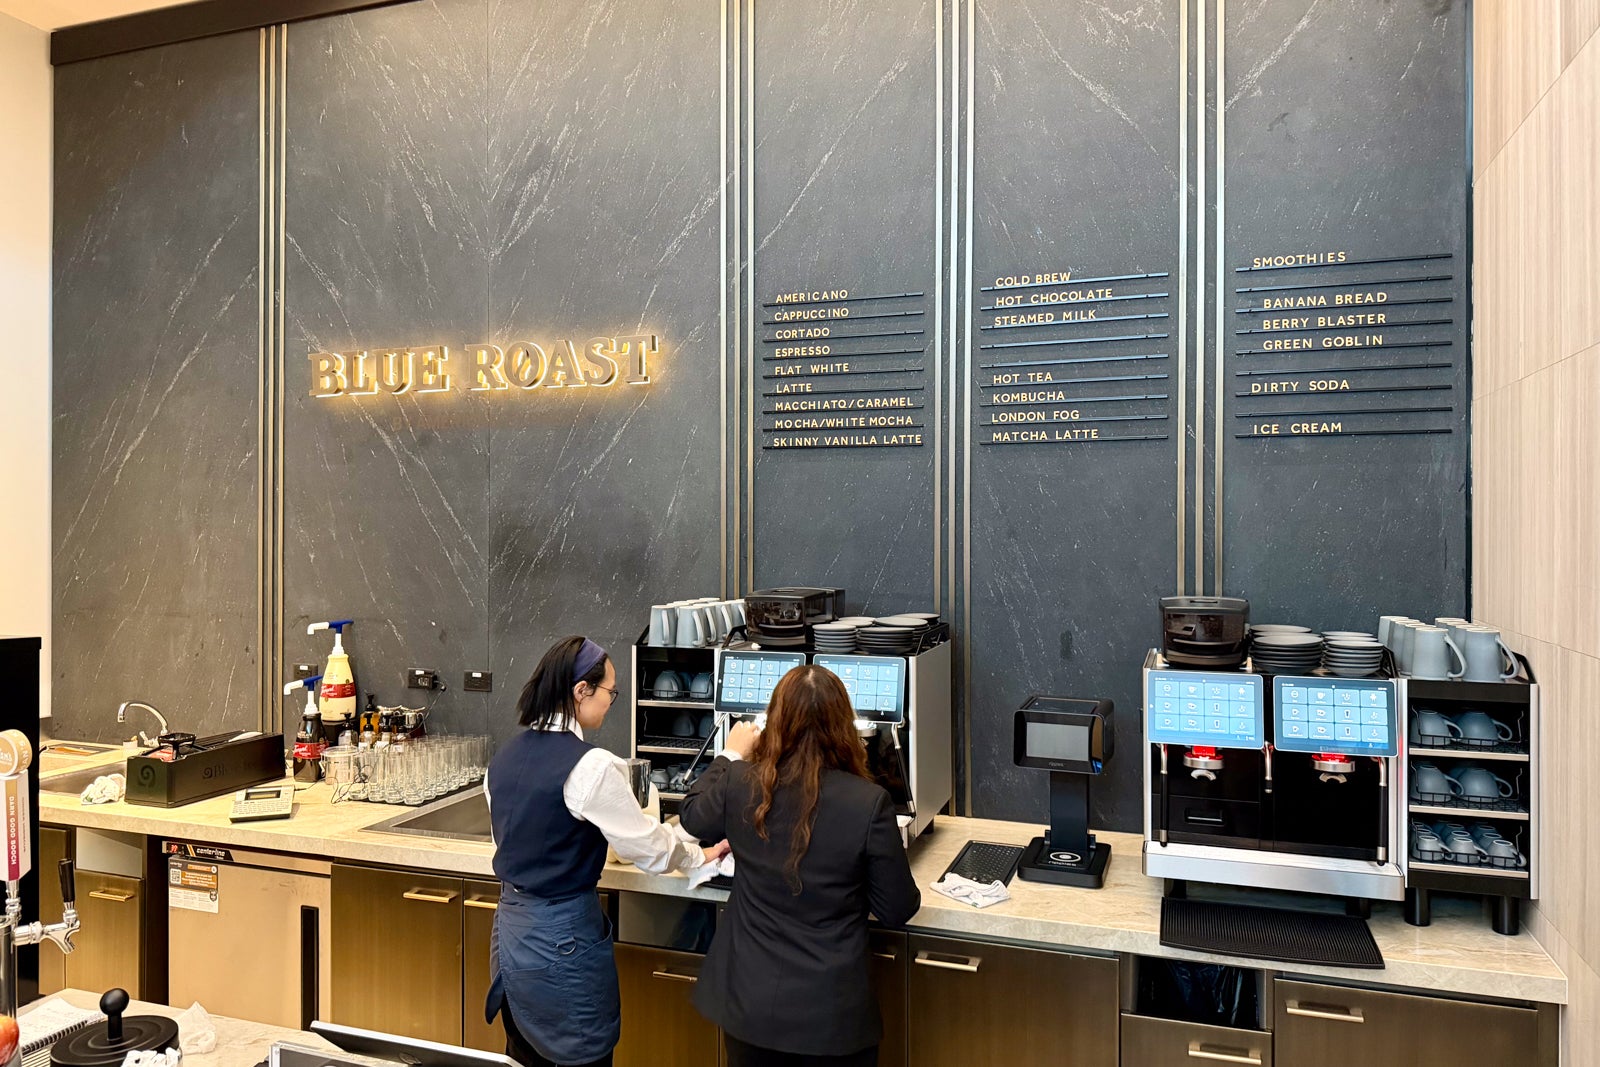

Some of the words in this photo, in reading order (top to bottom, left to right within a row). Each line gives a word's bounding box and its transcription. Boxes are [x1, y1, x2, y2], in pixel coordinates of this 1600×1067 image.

[1253, 251, 1346, 268] SMOOTHIES
[995, 275, 1030, 287] COLD
[1035, 272, 1071, 284] BREW
[776, 289, 848, 303] AMERICANO
[996, 295, 1023, 307] HOT
[1030, 288, 1113, 304] CHOCOLATE
[1263, 295, 1327, 309] BANANA
[1335, 292, 1388, 305] BREAD
[774, 307, 849, 321] CAPPUCCINO
[994, 312, 1054, 326] STEAMED
[1062, 309, 1097, 321] MILK
[1263, 317, 1309, 330] BERRY
[1317, 313, 1387, 327] BLASTER
[775, 327, 830, 339] CORTADO
[1263, 338, 1313, 350] GREEN
[1322, 334, 1383, 347] GOBLIN
[775, 345, 830, 357] ESPRESSO
[308, 345, 450, 398] BLUE
[465, 334, 658, 391] ROAST
[775, 365, 802, 376] FLAT
[810, 363, 849, 374] WHITE
[993, 373, 1020, 385] HOT
[1028, 371, 1053, 382] TEA
[776, 383, 813, 393] LATTE
[1251, 381, 1299, 393] DIRTY
[1309, 379, 1350, 391] SODA
[993, 390, 1065, 403] KOMBUCHA
[775, 417, 865, 429] MOCHA/WHITE
[869, 415, 914, 426] MOCHA
[991, 411, 1046, 423] LONDON
[1053, 409, 1080, 420] FOG
[992, 430, 1048, 442] MATCHA
[1055, 428, 1099, 440] LATTE
[1253, 424, 1280, 435] ICE
[1290, 422, 1342, 434] CREAM
[773, 436, 819, 447] SKINNY
[824, 435, 878, 446] VANILLA
[883, 434, 922, 444] LATTE
